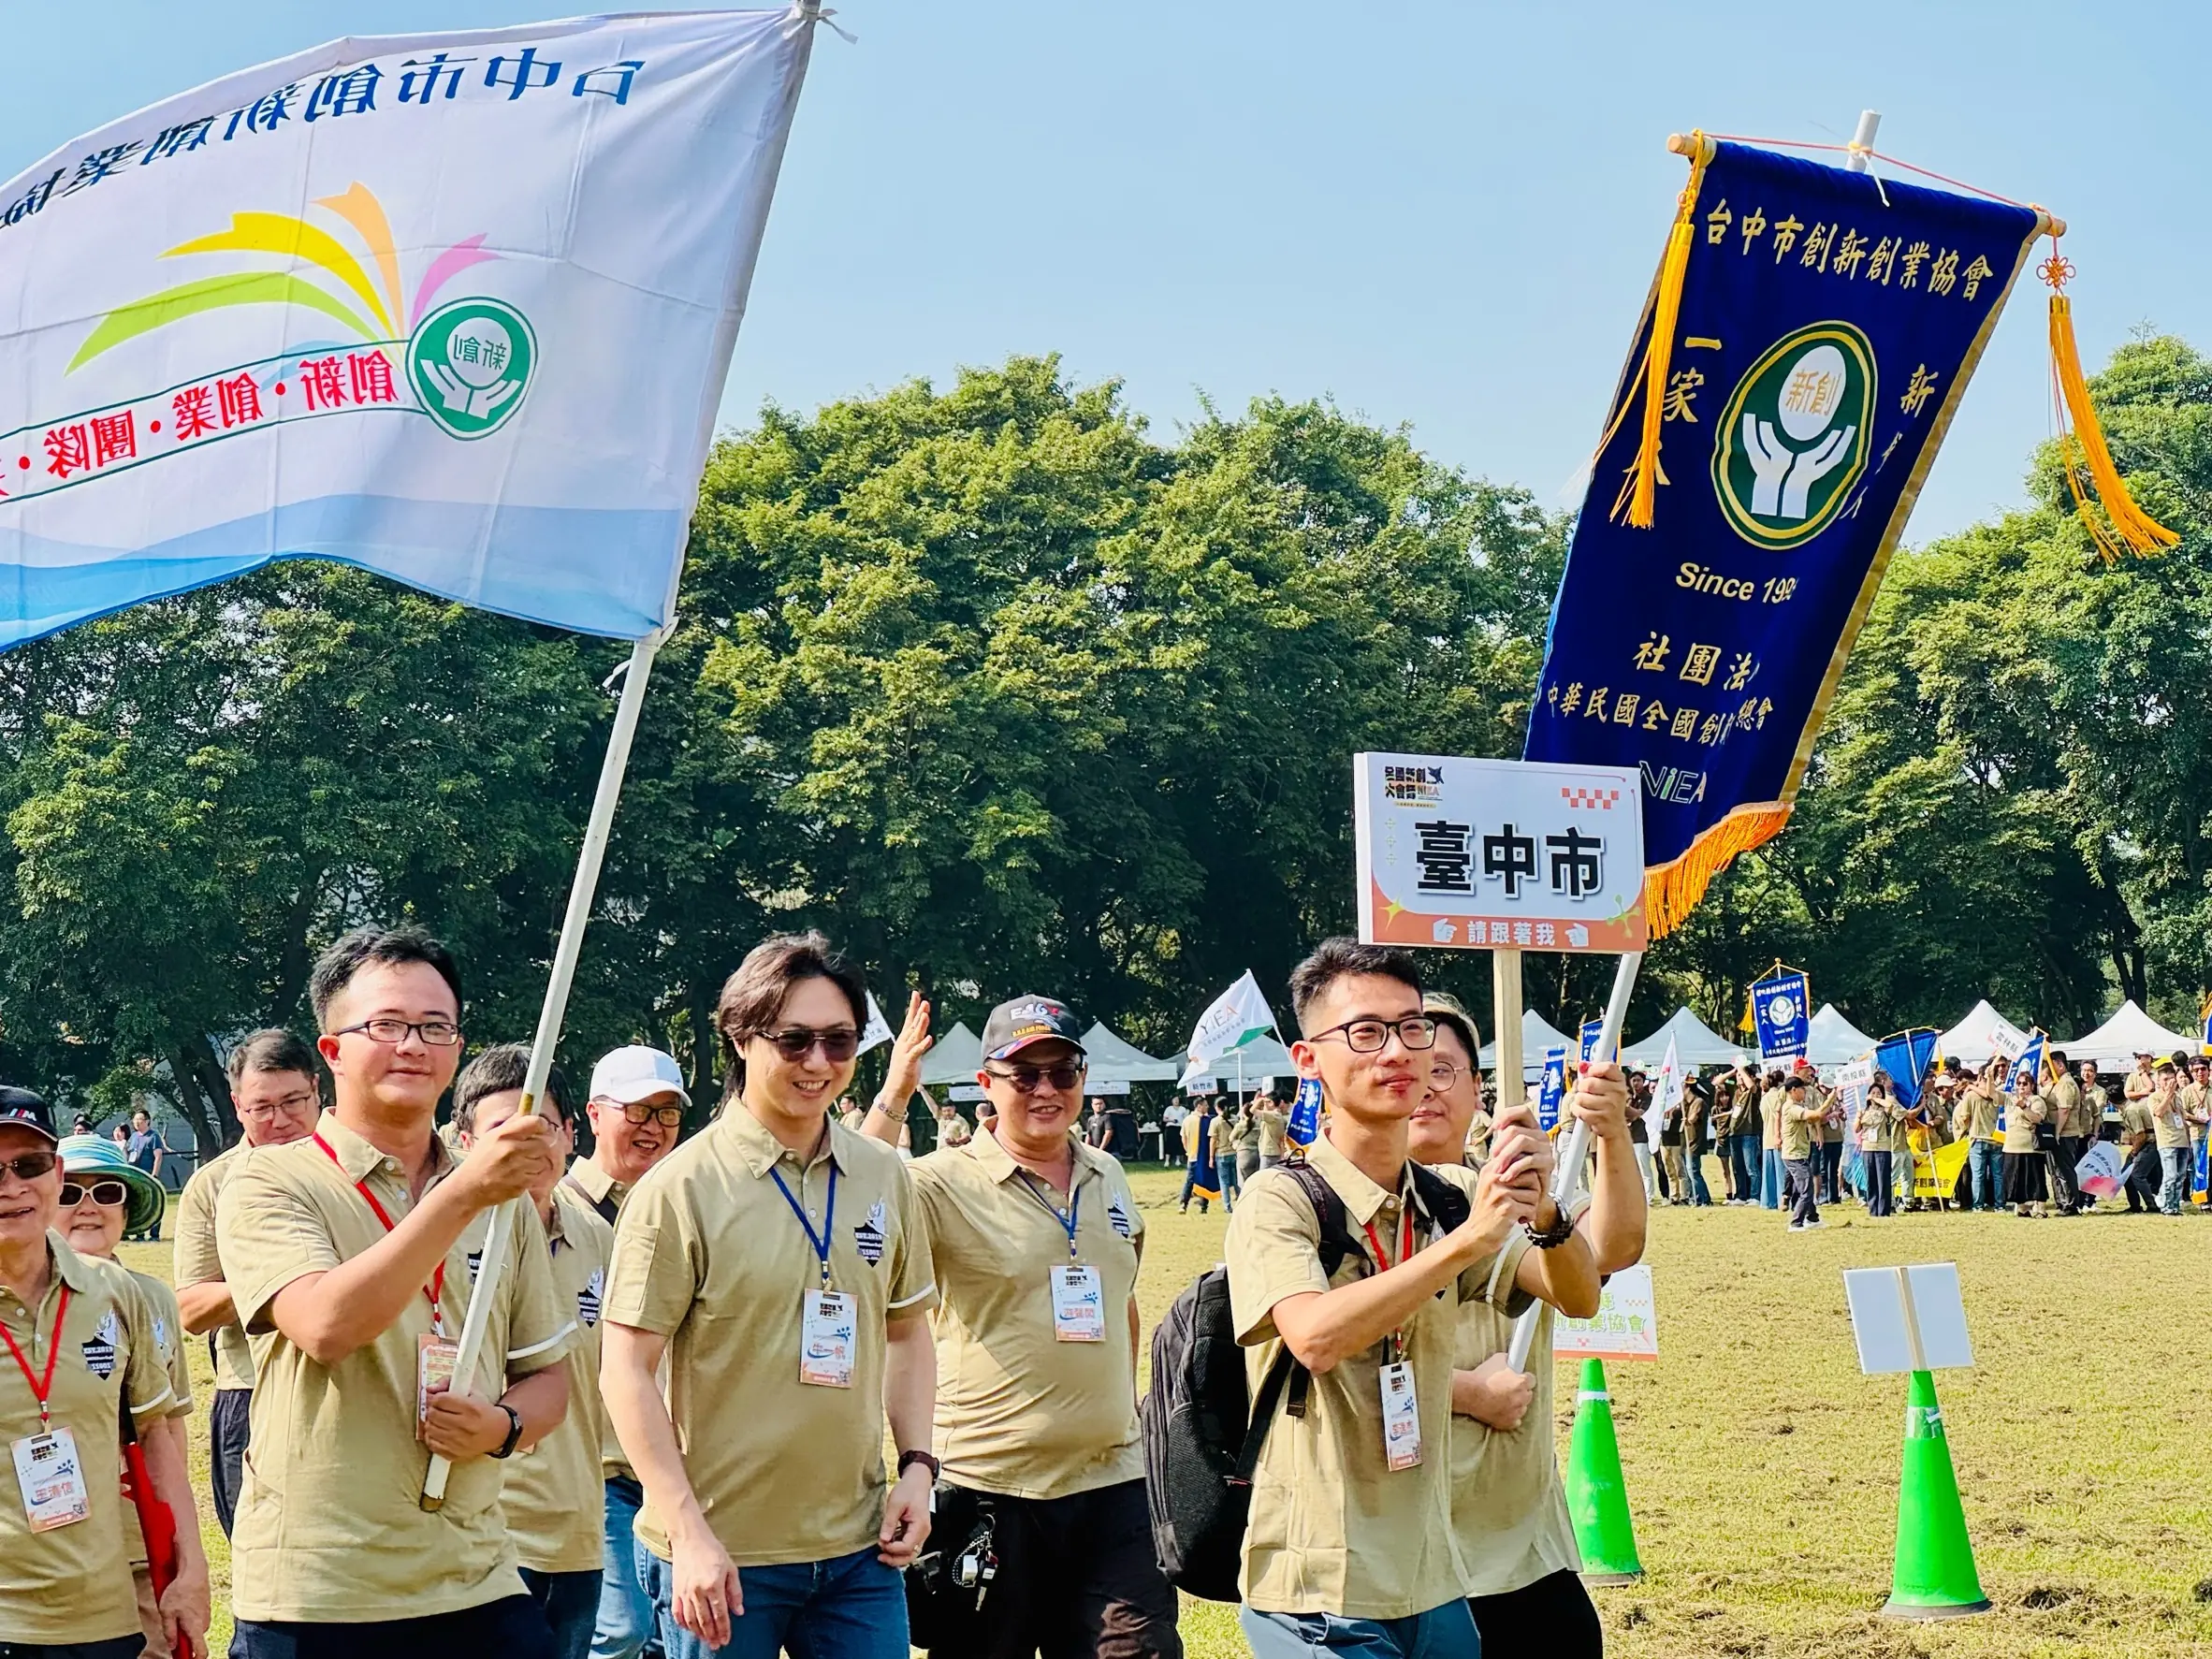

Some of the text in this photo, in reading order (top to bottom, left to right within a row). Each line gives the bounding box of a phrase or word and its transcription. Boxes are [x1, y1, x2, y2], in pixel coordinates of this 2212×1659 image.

[1707, 197, 1995, 302] 台中市創新創業協會
[1783, 367, 1843, 417] 新創
[1675, 561, 1755, 602] Since
[1414, 819, 1603, 900] 臺中市
[1467, 920, 1556, 947] 請跟著我
